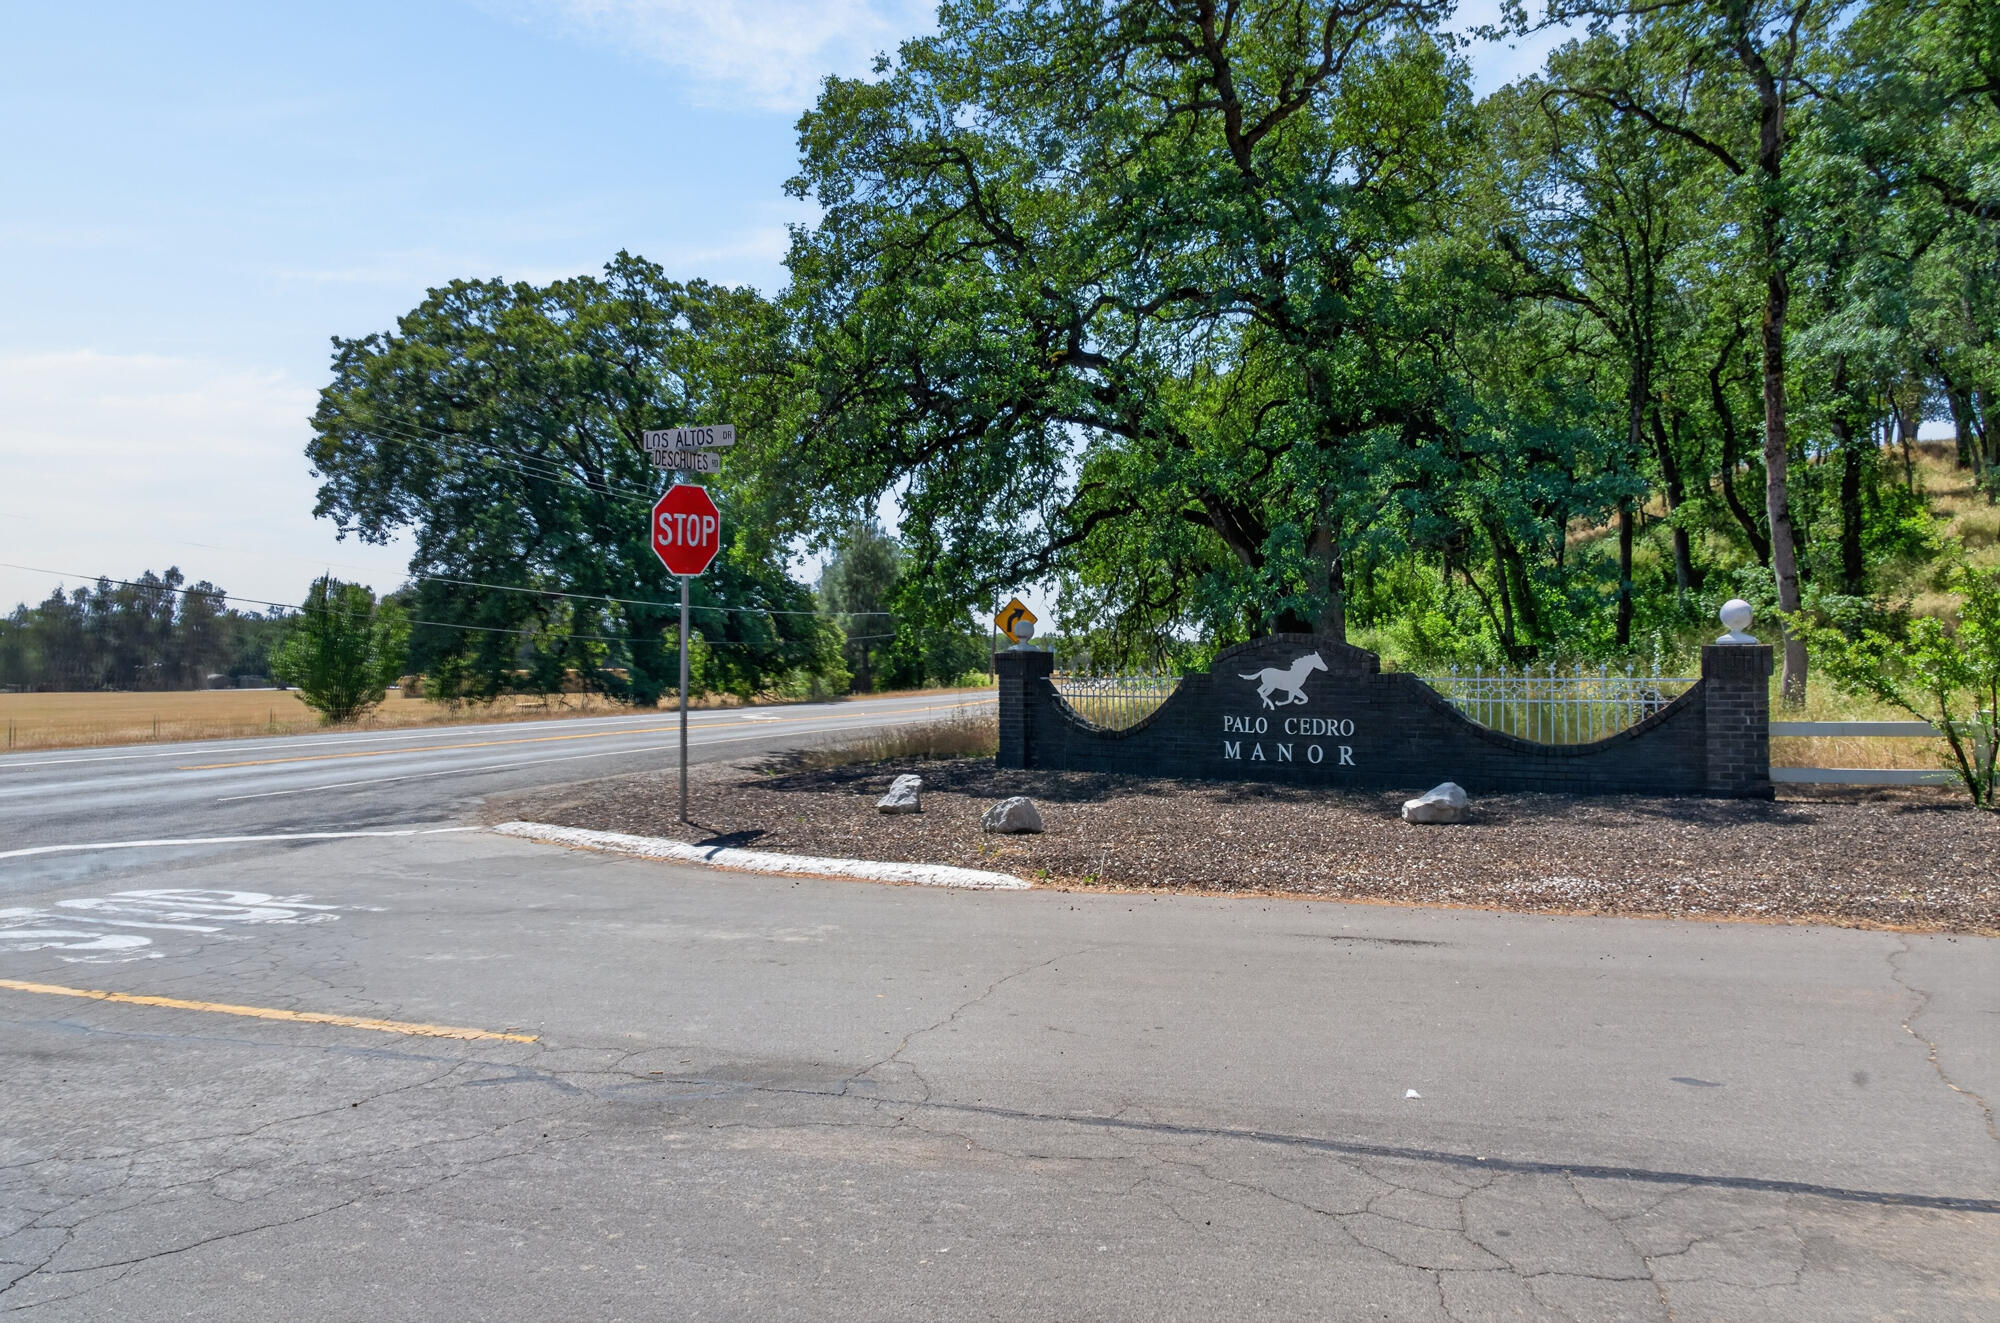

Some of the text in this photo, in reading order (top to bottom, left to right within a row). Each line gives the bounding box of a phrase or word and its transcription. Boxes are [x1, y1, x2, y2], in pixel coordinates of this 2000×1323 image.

[645, 428, 732, 450] LOS ALTOS DR
[655, 449, 709, 471] DESCHUTES
[657, 512, 716, 547] STOP
[1223, 715, 1355, 737] PALO CEDRO
[1223, 740, 1356, 766] MANOR
